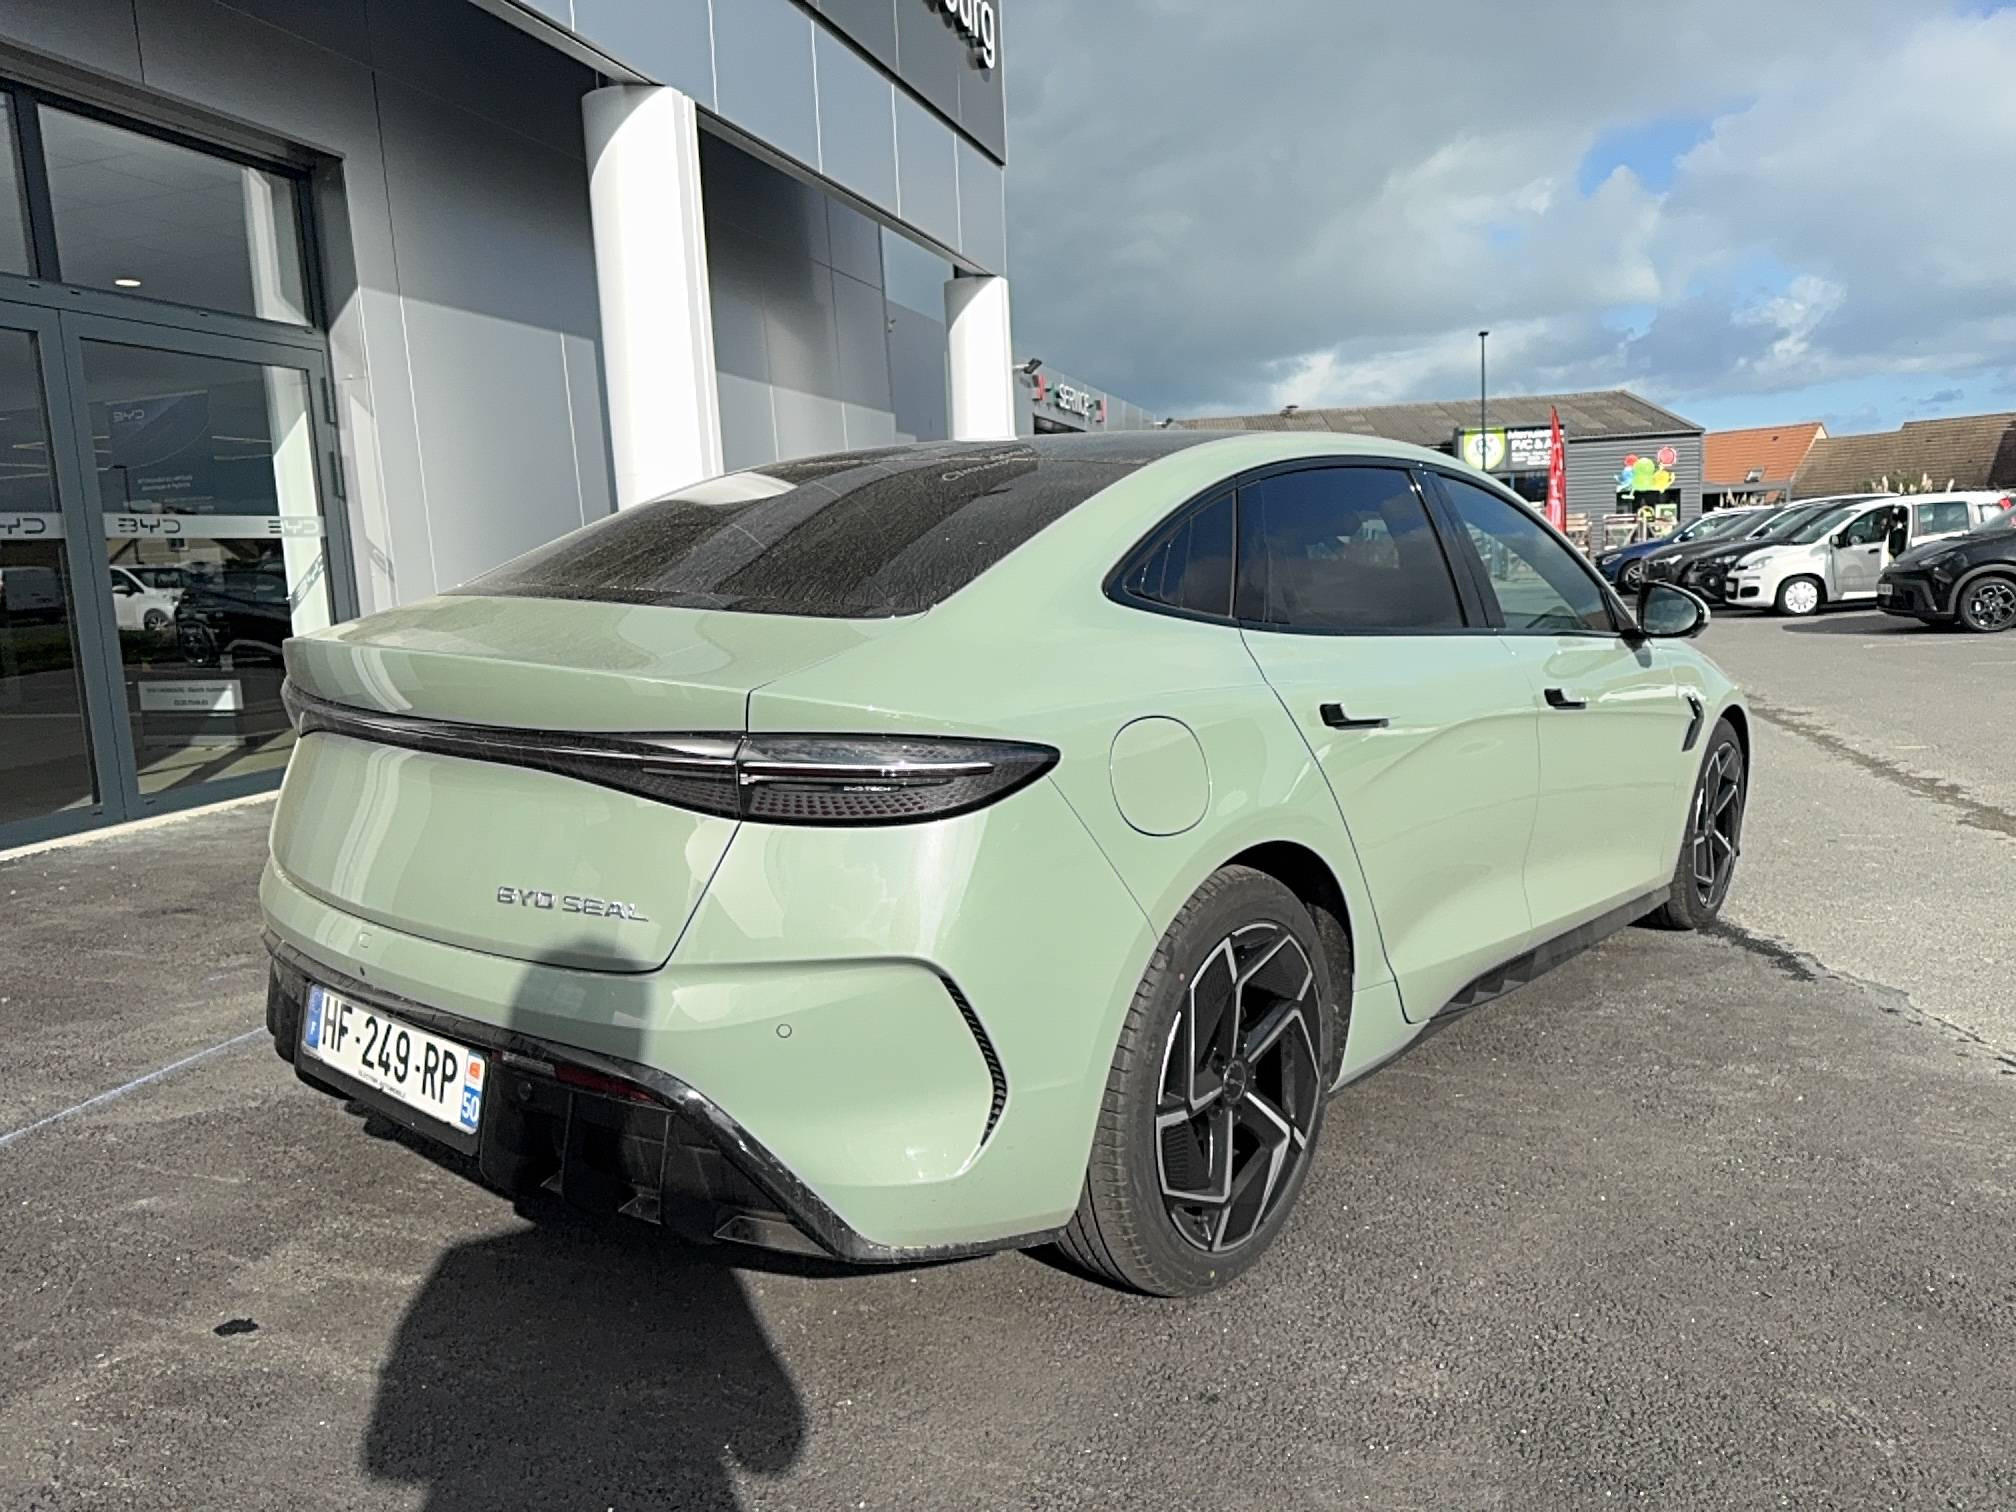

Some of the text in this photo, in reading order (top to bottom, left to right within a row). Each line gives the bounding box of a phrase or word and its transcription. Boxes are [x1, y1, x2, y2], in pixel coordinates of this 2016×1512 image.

[1059, 383, 1089, 416] SERVICE
[113, 409, 145, 422] BYD
[117, 517, 182, 534] BYD
[267, 519, 321, 535] BYD
[497, 885, 649, 923] BYD SEAL
[310, 1020, 317, 1035] F
[322, 995, 458, 1105] HF-249-RP
[460, 1090, 480, 1125] 50
